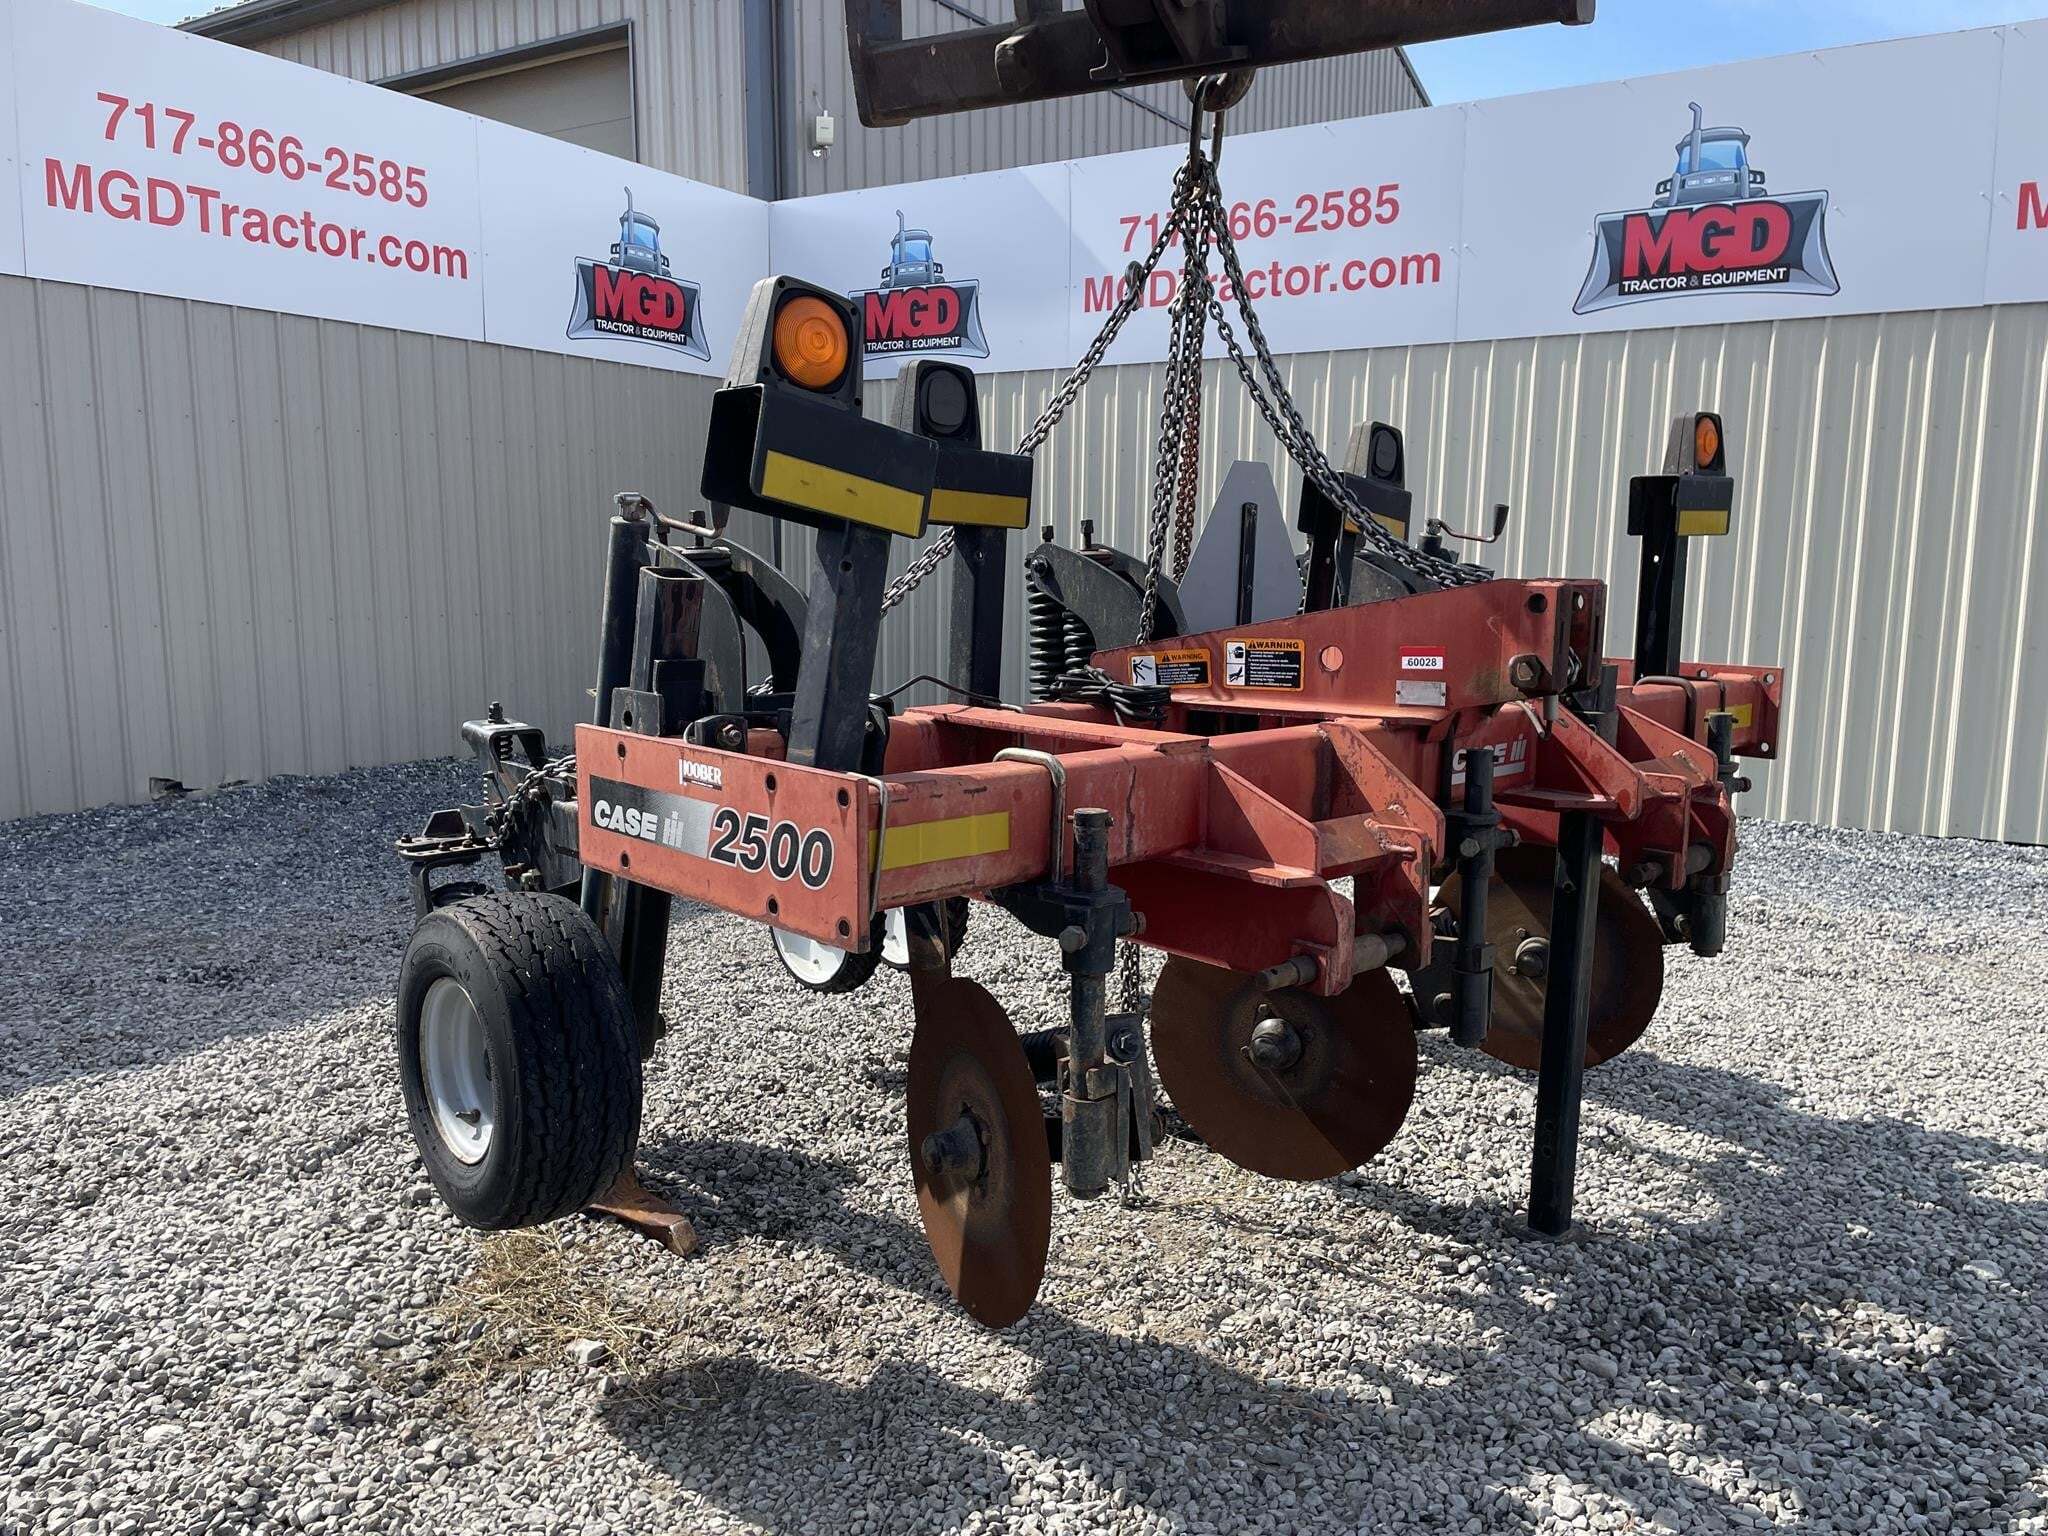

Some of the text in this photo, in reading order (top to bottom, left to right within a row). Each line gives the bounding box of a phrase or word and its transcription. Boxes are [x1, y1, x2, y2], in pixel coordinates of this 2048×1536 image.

[97, 92, 428, 208] 717-866-2585
[45, 157, 468, 279] MGDTractor.com
[1119, 184, 1400, 252] 7166-2585
[1622, 200, 1793, 278] MGD
[593, 263, 685, 330] MGD
[1623, 268, 1788, 293] TRACTOR & EQUIPMENT
[596, 318, 634, 335] TRACTOR
[642, 327, 685, 344] EQUIPMENT
[865, 285, 960, 340] MGD
[866, 340, 905, 352] TRACTOR
[912, 336, 960, 348] EQUIPMENT
[1171, 652, 1204, 661] WARNING
[1256, 641, 1299, 650] WARNING
[1407, 657, 1438, 667] 60028
[593, 800, 658, 840] CASE
[709, 806, 834, 890] 2500
